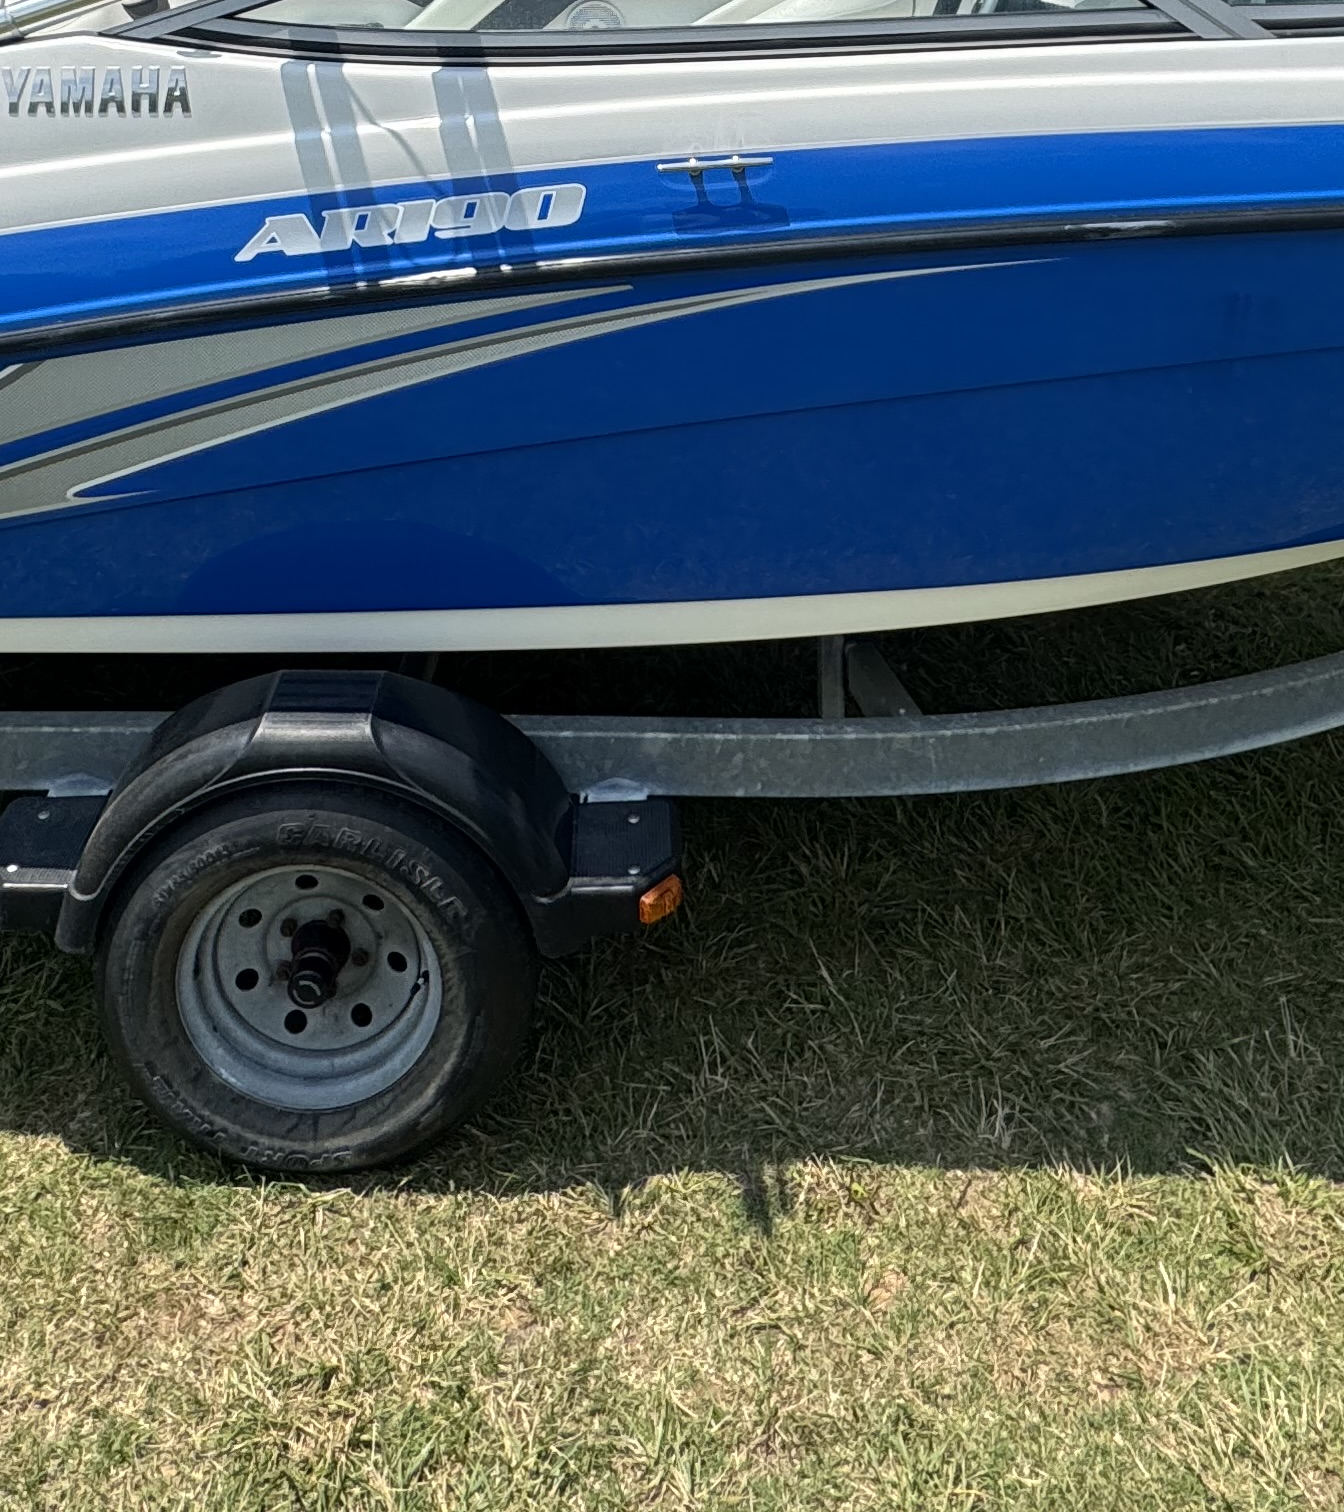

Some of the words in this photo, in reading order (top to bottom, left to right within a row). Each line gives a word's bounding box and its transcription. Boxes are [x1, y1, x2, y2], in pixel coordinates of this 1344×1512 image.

[0, 66, 194, 117] YAMAHA
[233, 183, 588, 262] AR190
[276, 823, 469, 920] CARLISLE
[240, 1144, 354, 1170] SPORT
